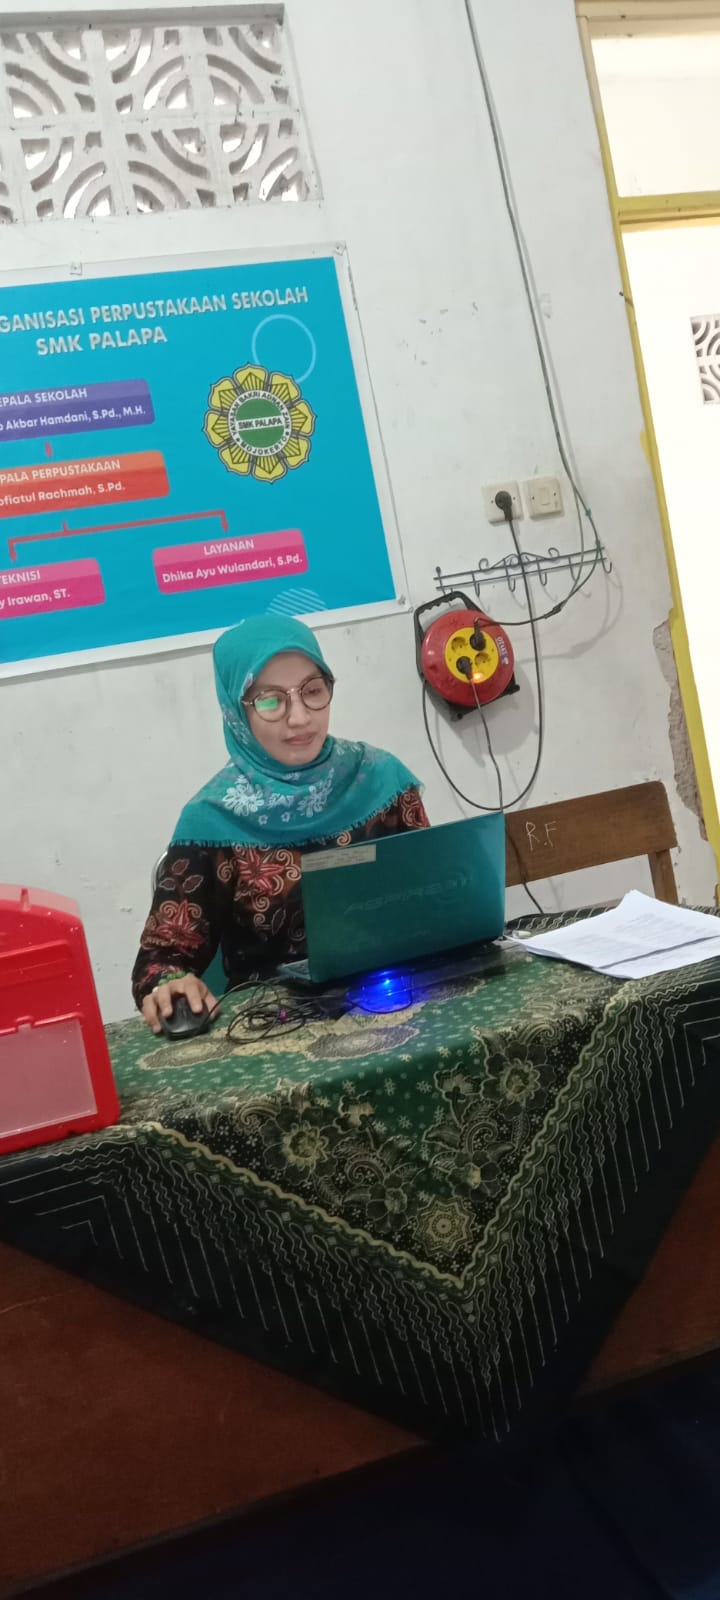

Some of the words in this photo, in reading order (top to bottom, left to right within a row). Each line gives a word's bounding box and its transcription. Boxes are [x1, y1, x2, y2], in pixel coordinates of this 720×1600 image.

[90, 294, 228, 324] PERPUSTAKAAN
[231, 286, 309, 310] SEKOLAH
[36, 334, 83, 356] SMK
[89, 326, 168, 350] PALAPA
[34, 388, 88, 403] SEKOLAH
[6, 418, 39, 431] Akbar
[40, 410, 92, 427] Hamdani,
[123, 405, 147, 416] M.H.
[238, 420, 254, 430] SMK
[254, 417, 282, 427] PALAPA
[32, 459, 121, 480] PERPUSTAKAAN
[38, 486, 97, 501] Rachmah,
[97, 481, 126, 494] S.Pd.
[203, 539, 255, 556] LAYANAN
[0, 569, 41, 585] EKNISI
[162, 570, 195, 583] Dhika
[195, 567, 216, 579] Ayu
[217, 557, 277, 575] Wulandari,
[277, 554, 303, 566] S.Pd.
[7, 593, 53, 606] Irawan,
[53, 588, 71, 599] ST.
